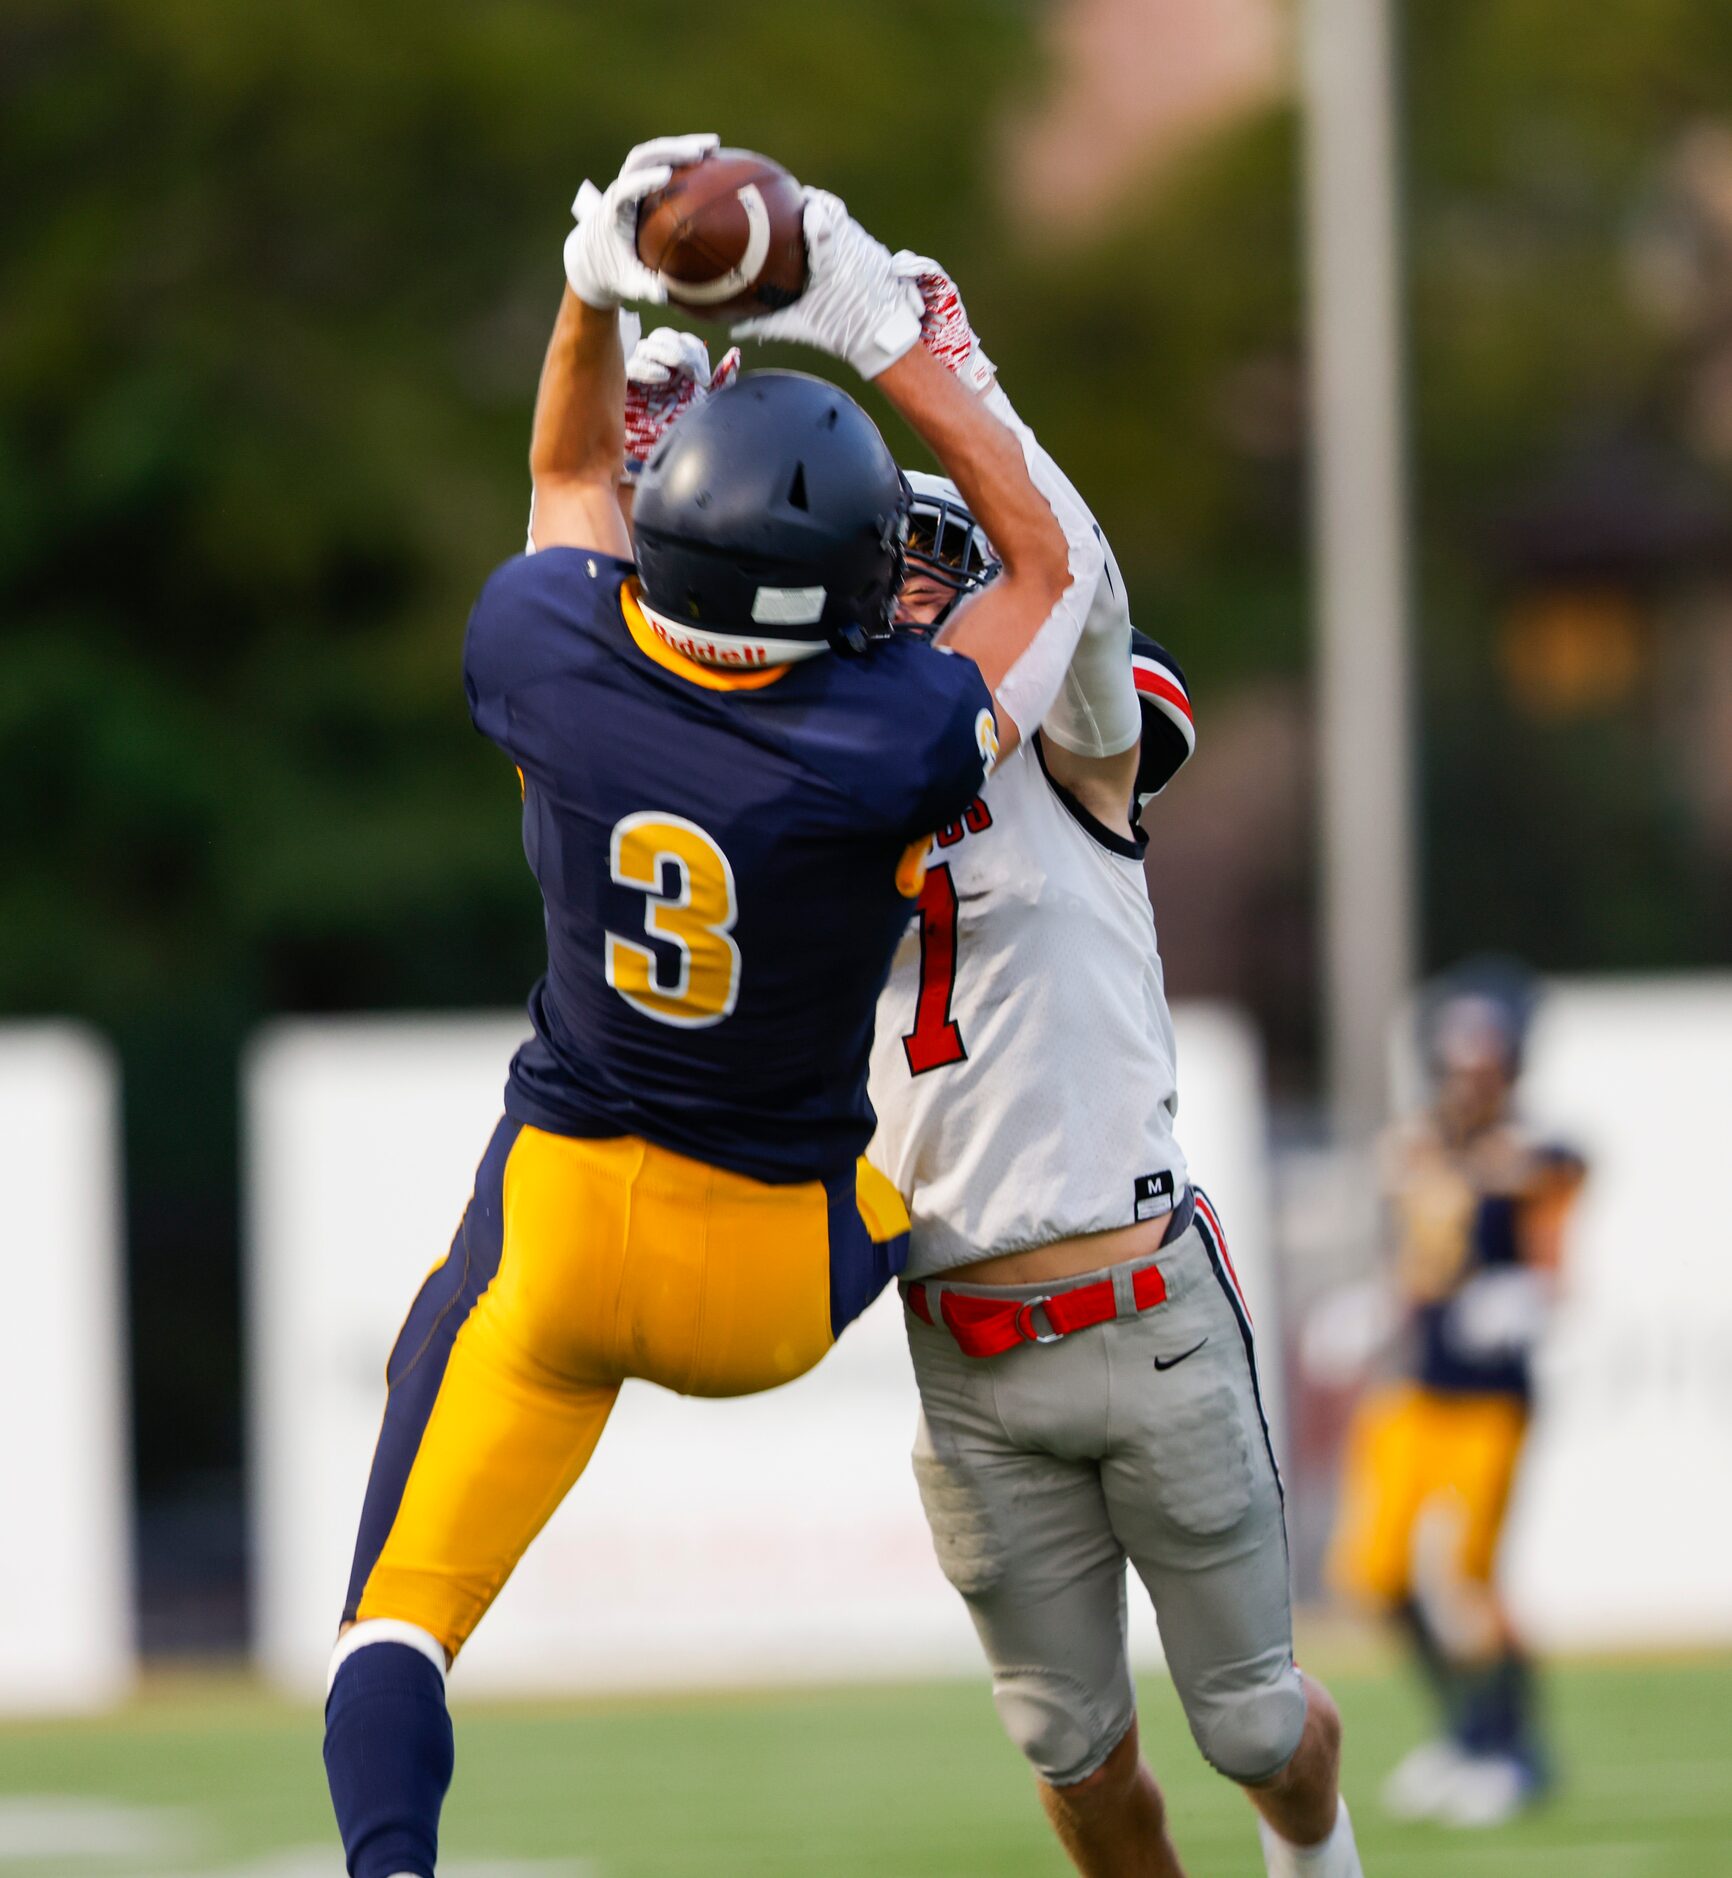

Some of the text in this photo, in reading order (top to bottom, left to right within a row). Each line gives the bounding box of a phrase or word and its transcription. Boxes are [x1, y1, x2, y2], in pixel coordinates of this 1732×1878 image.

[652, 620, 767, 668] Riddell
[605, 810, 741, 1029] 3
[1147, 1177, 1163, 1195] M
